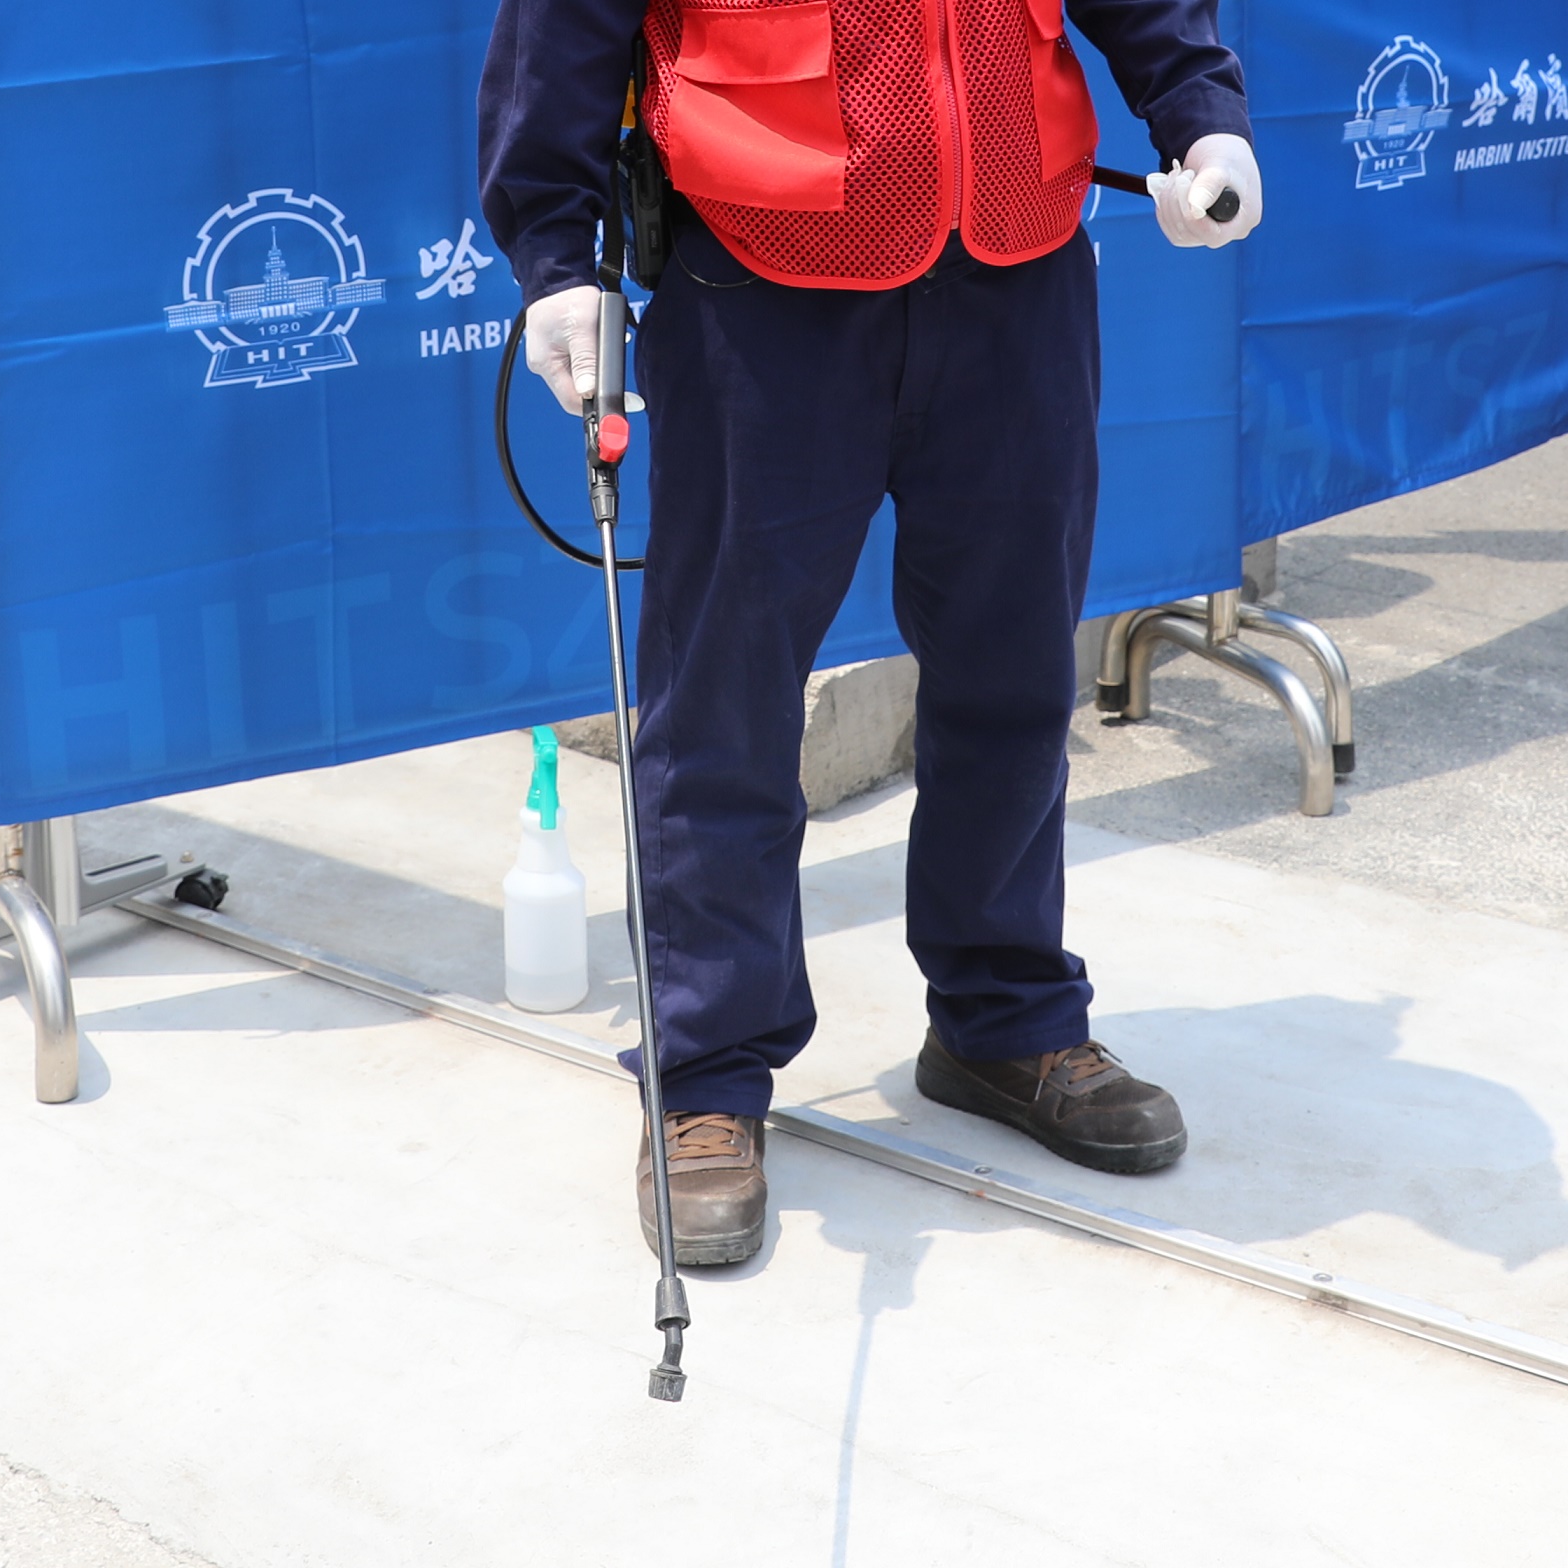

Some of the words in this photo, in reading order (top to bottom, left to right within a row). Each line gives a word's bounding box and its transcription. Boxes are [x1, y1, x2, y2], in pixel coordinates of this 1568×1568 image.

[1374, 156, 1407, 171] HIT
[1454, 142, 1514, 172] HARBIN
[258, 321, 301, 336] 1920
[420, 318, 524, 358] HARBI
[247, 342, 314, 364] HIT
